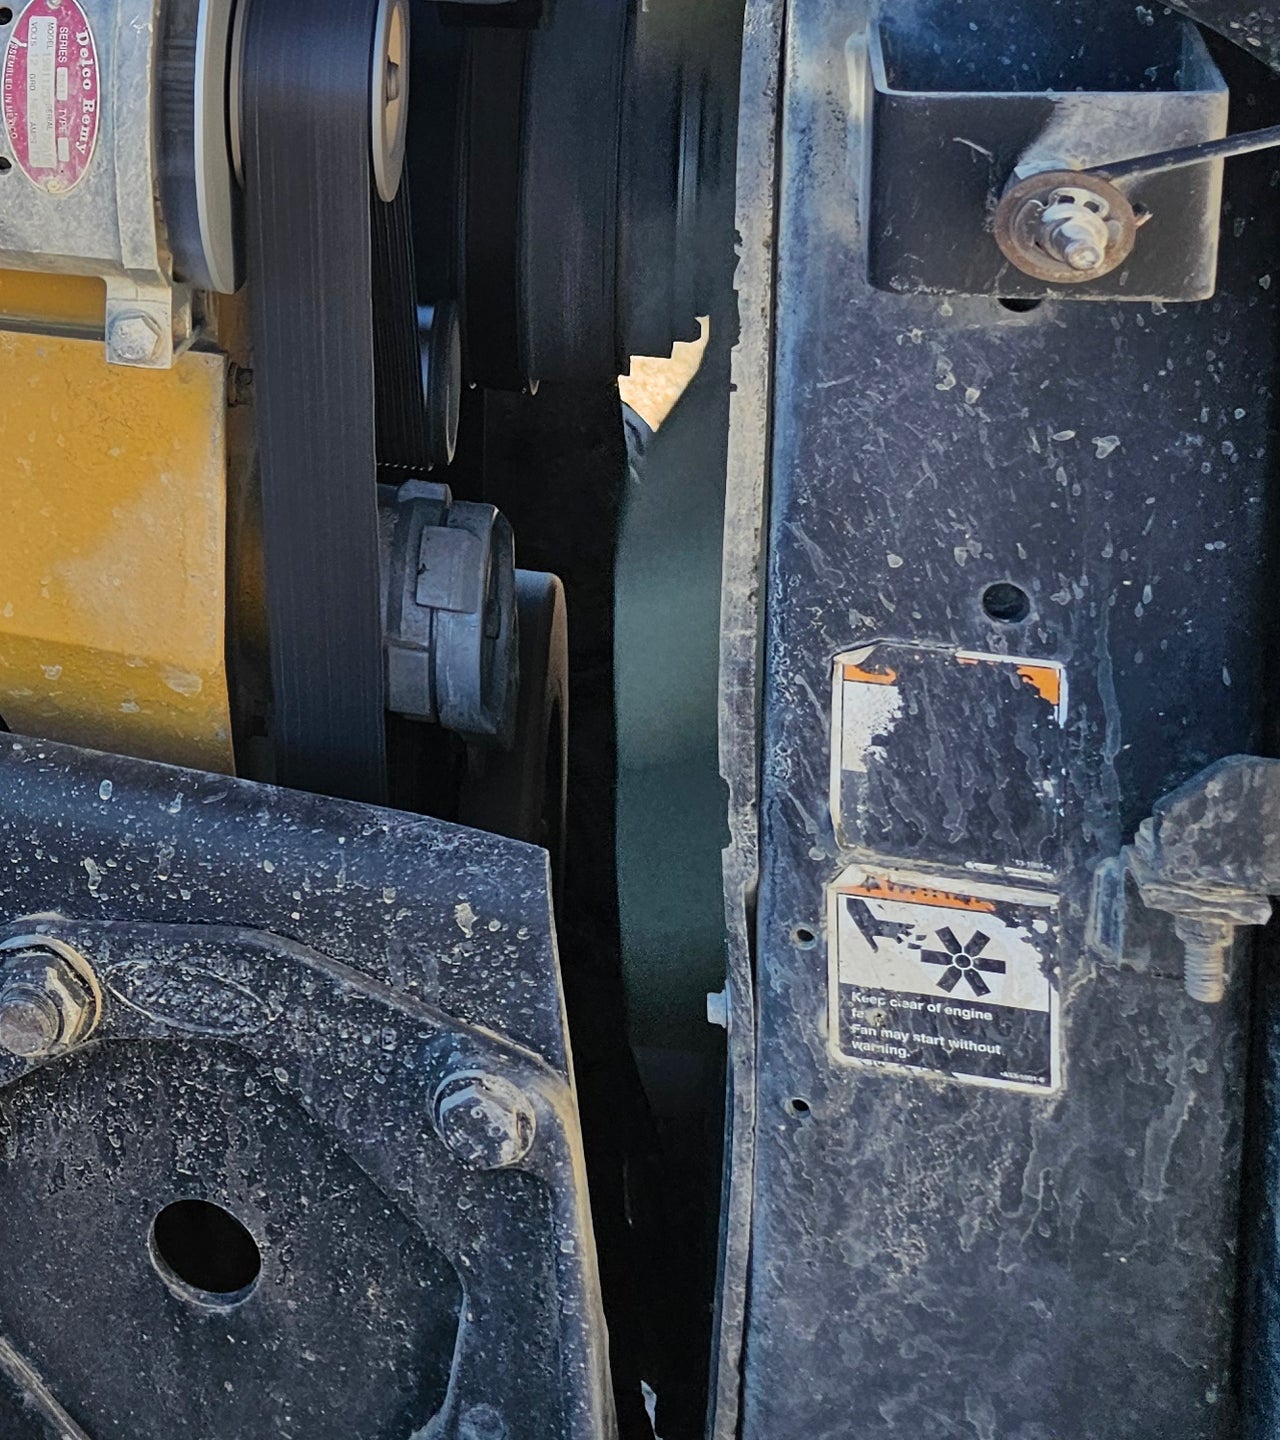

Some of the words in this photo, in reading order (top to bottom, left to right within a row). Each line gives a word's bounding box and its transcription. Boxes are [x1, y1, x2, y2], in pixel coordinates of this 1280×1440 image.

[46, 22, 54, 50] MODEL
[58, 26, 69, 64] SERIES
[5, 43, 19, 90] SSEMBLED
[75, 30, 93, 91] Delco
[4, 92, 12, 103] IN
[58, 108, 68, 134] TYPE
[76, 98, 96, 155] Remy
[851, 990, 887, 1006] Keep
[926, 1002, 942, 1014] of
[944, 1005, 994, 1024] engine
[851, 1024, 880, 1038] Fan
[881, 1027, 910, 1044] may
[912, 1032, 946, 1048] start
[948, 1036, 1002, 1056] without
